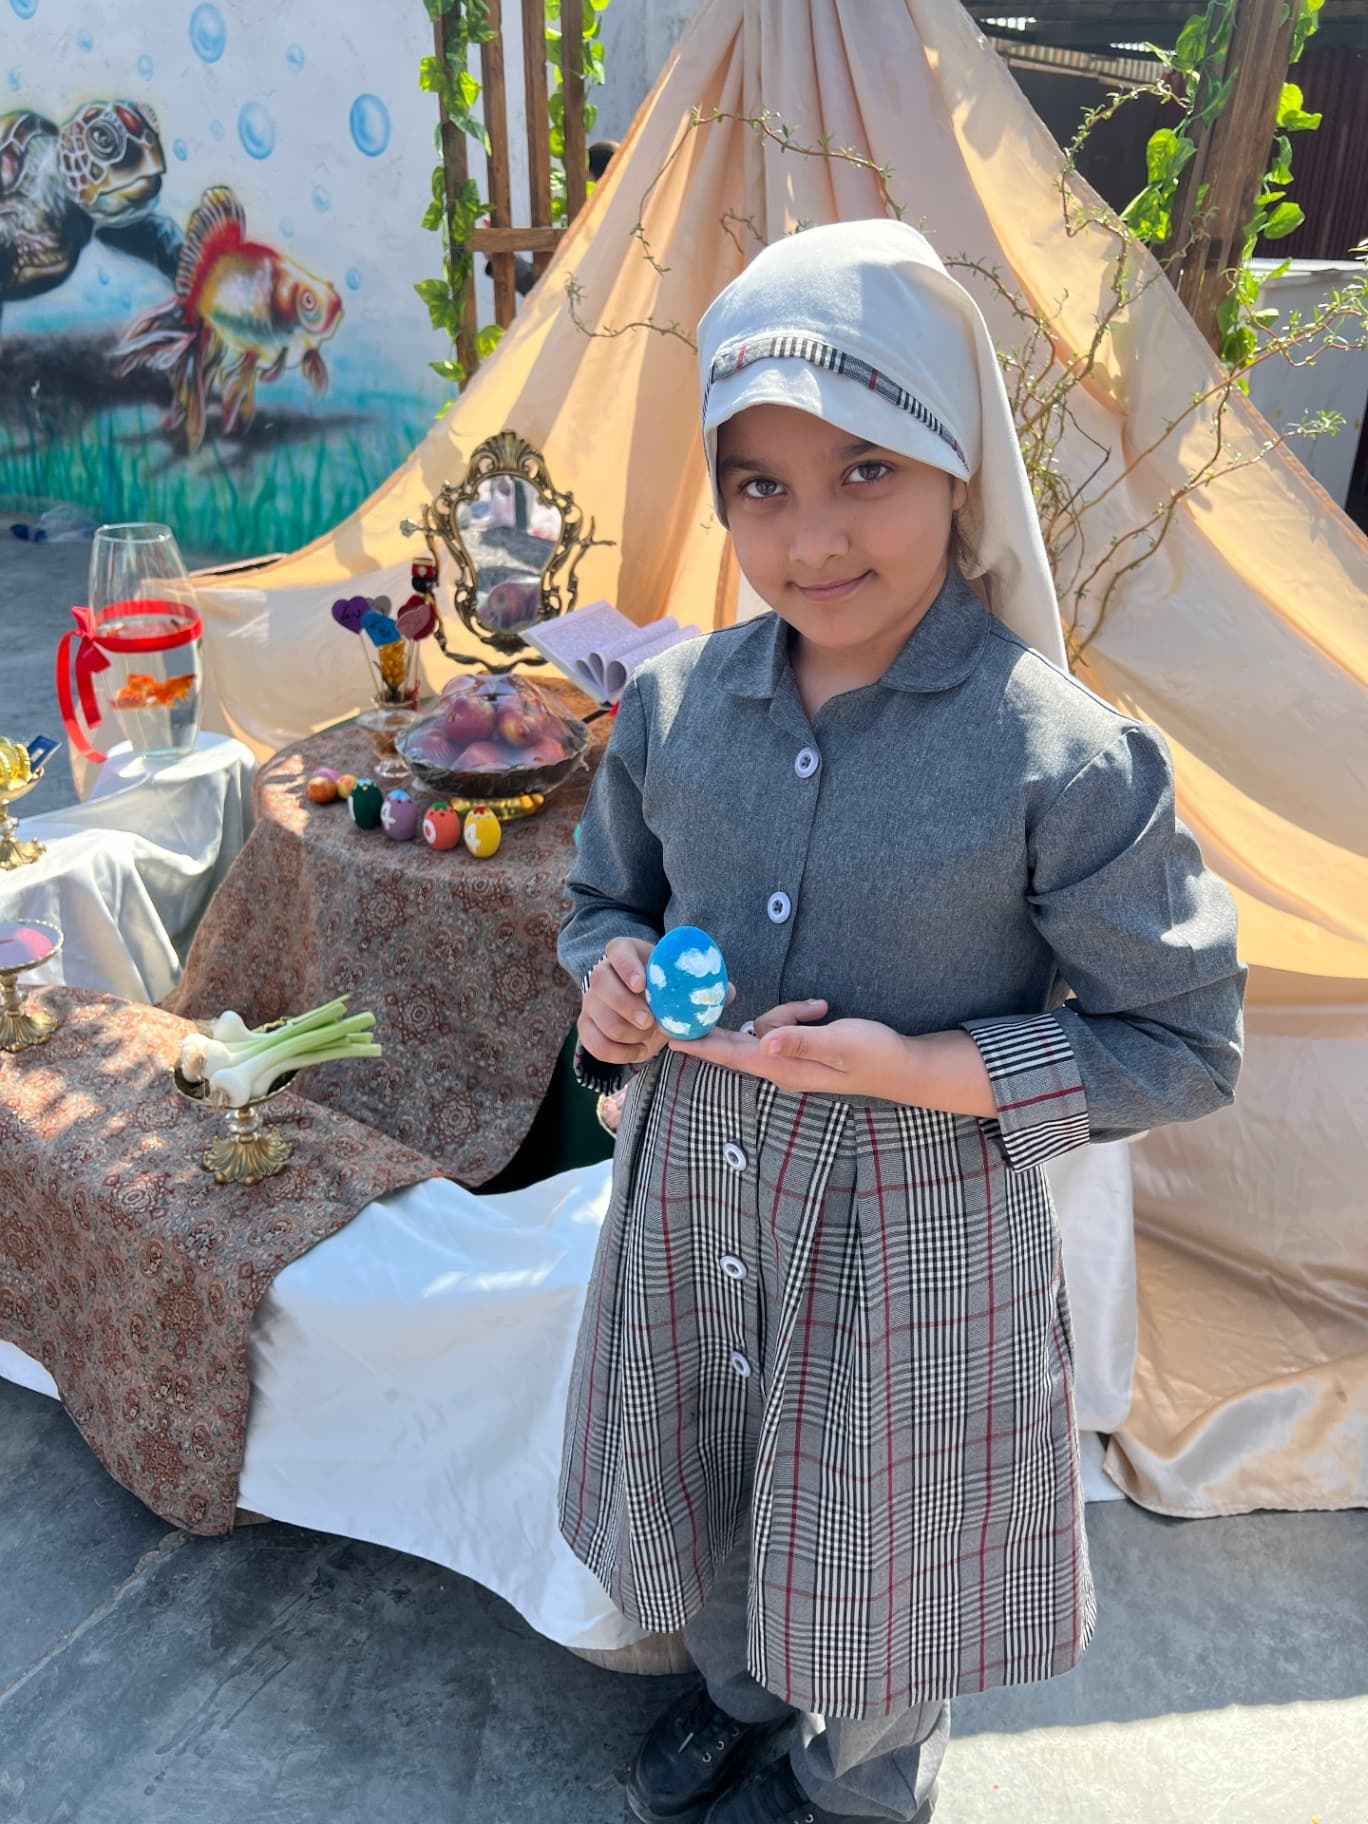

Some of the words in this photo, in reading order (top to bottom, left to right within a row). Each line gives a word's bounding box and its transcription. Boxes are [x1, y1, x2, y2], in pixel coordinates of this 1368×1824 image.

[381, 801, 396, 831] 4
[423, 818, 436, 844] 0
[464, 823, 481, 855] 4
